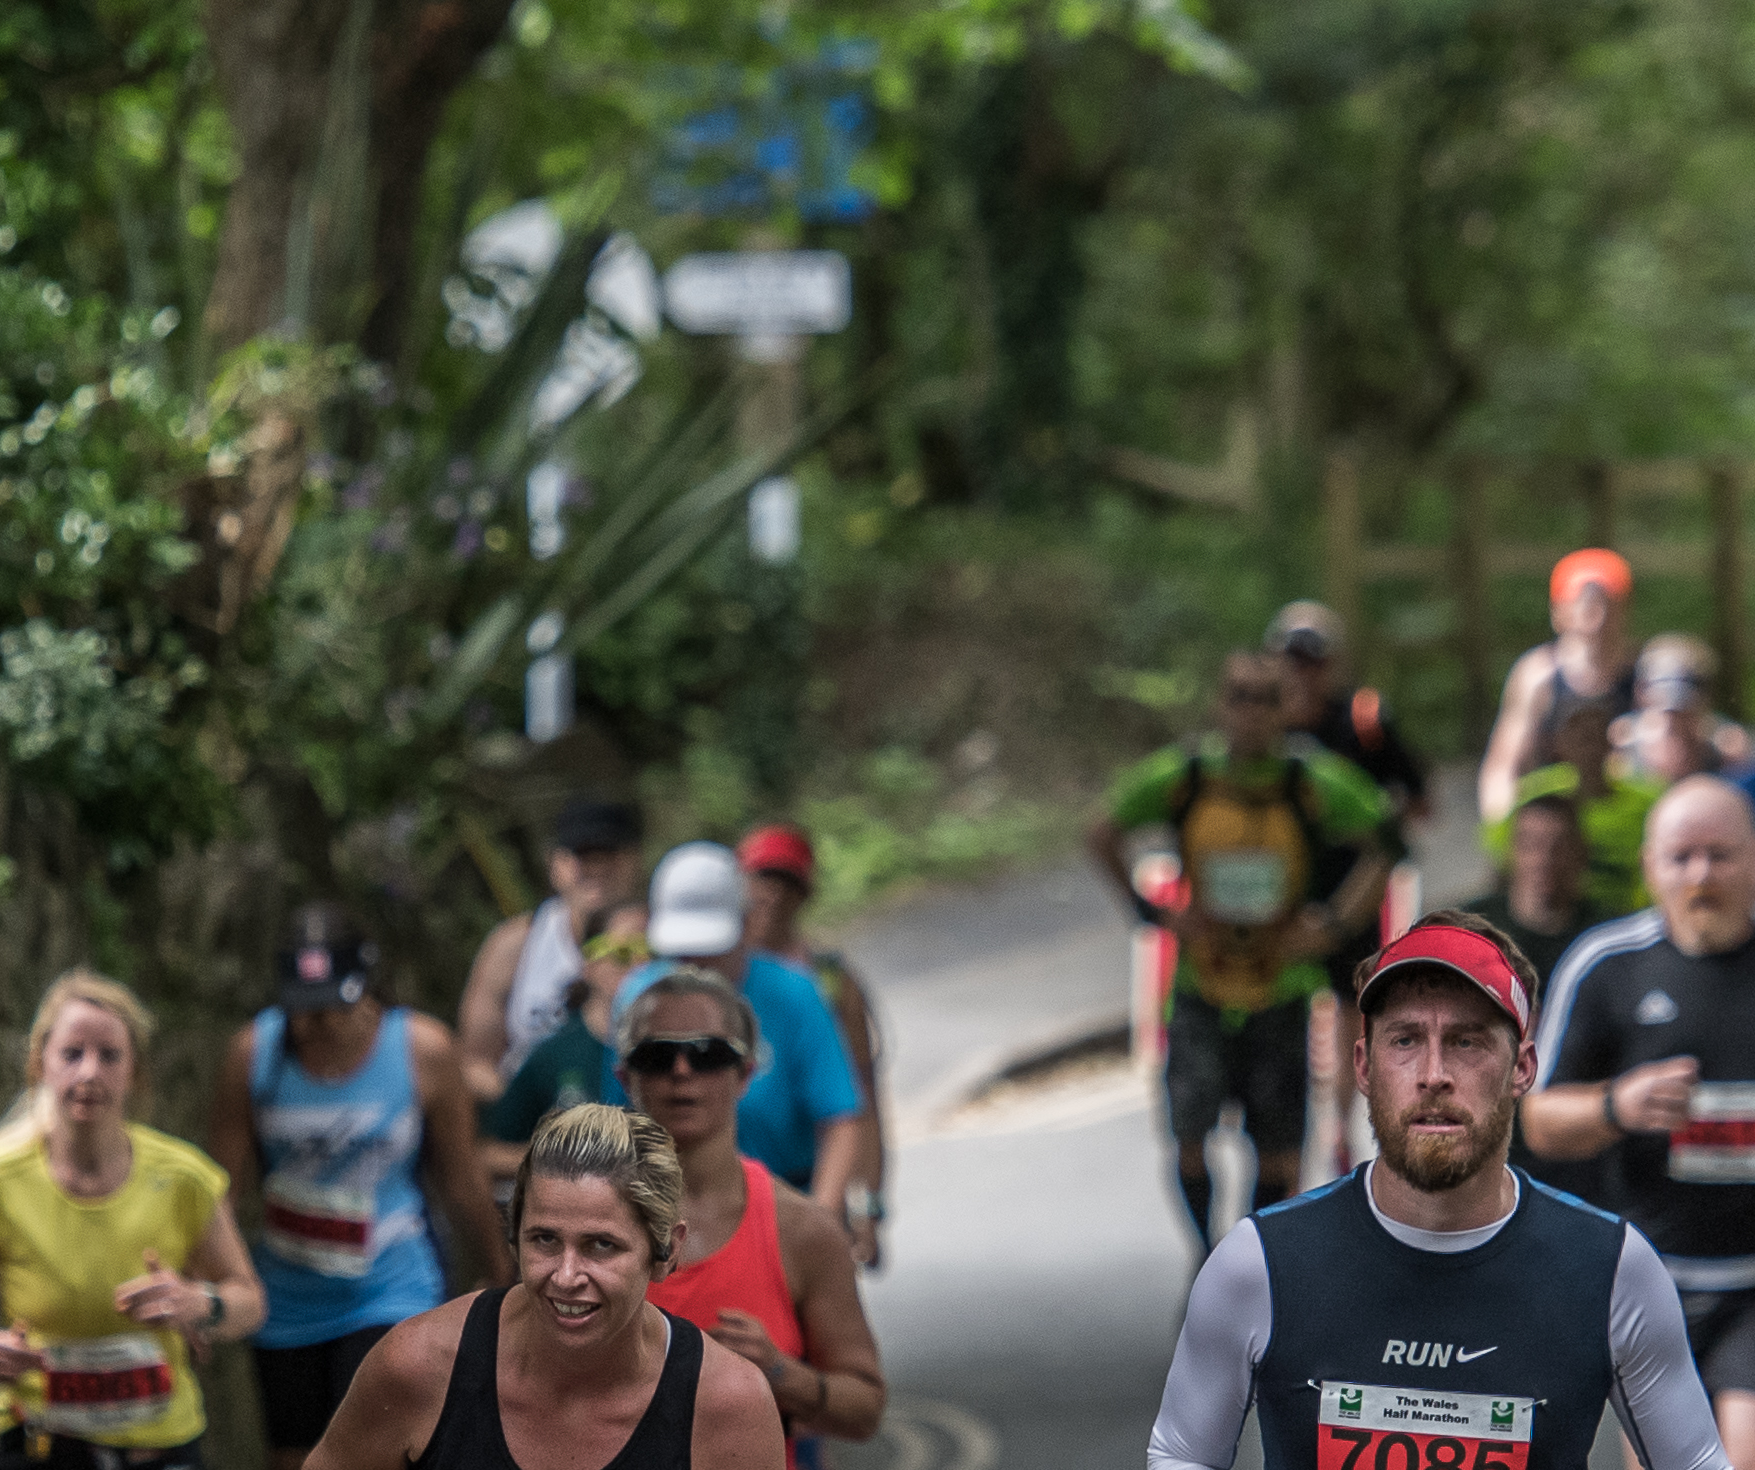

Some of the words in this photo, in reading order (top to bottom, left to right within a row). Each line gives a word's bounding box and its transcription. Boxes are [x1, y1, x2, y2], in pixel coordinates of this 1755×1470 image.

[1382, 1339, 1453, 1368] RUN
[1396, 1395, 1419, 1407] The
[1422, 1398, 1459, 1410] Wales
[1383, 1407, 1409, 1420] Half
[1412, 1411, 1469, 1424] Marathon
